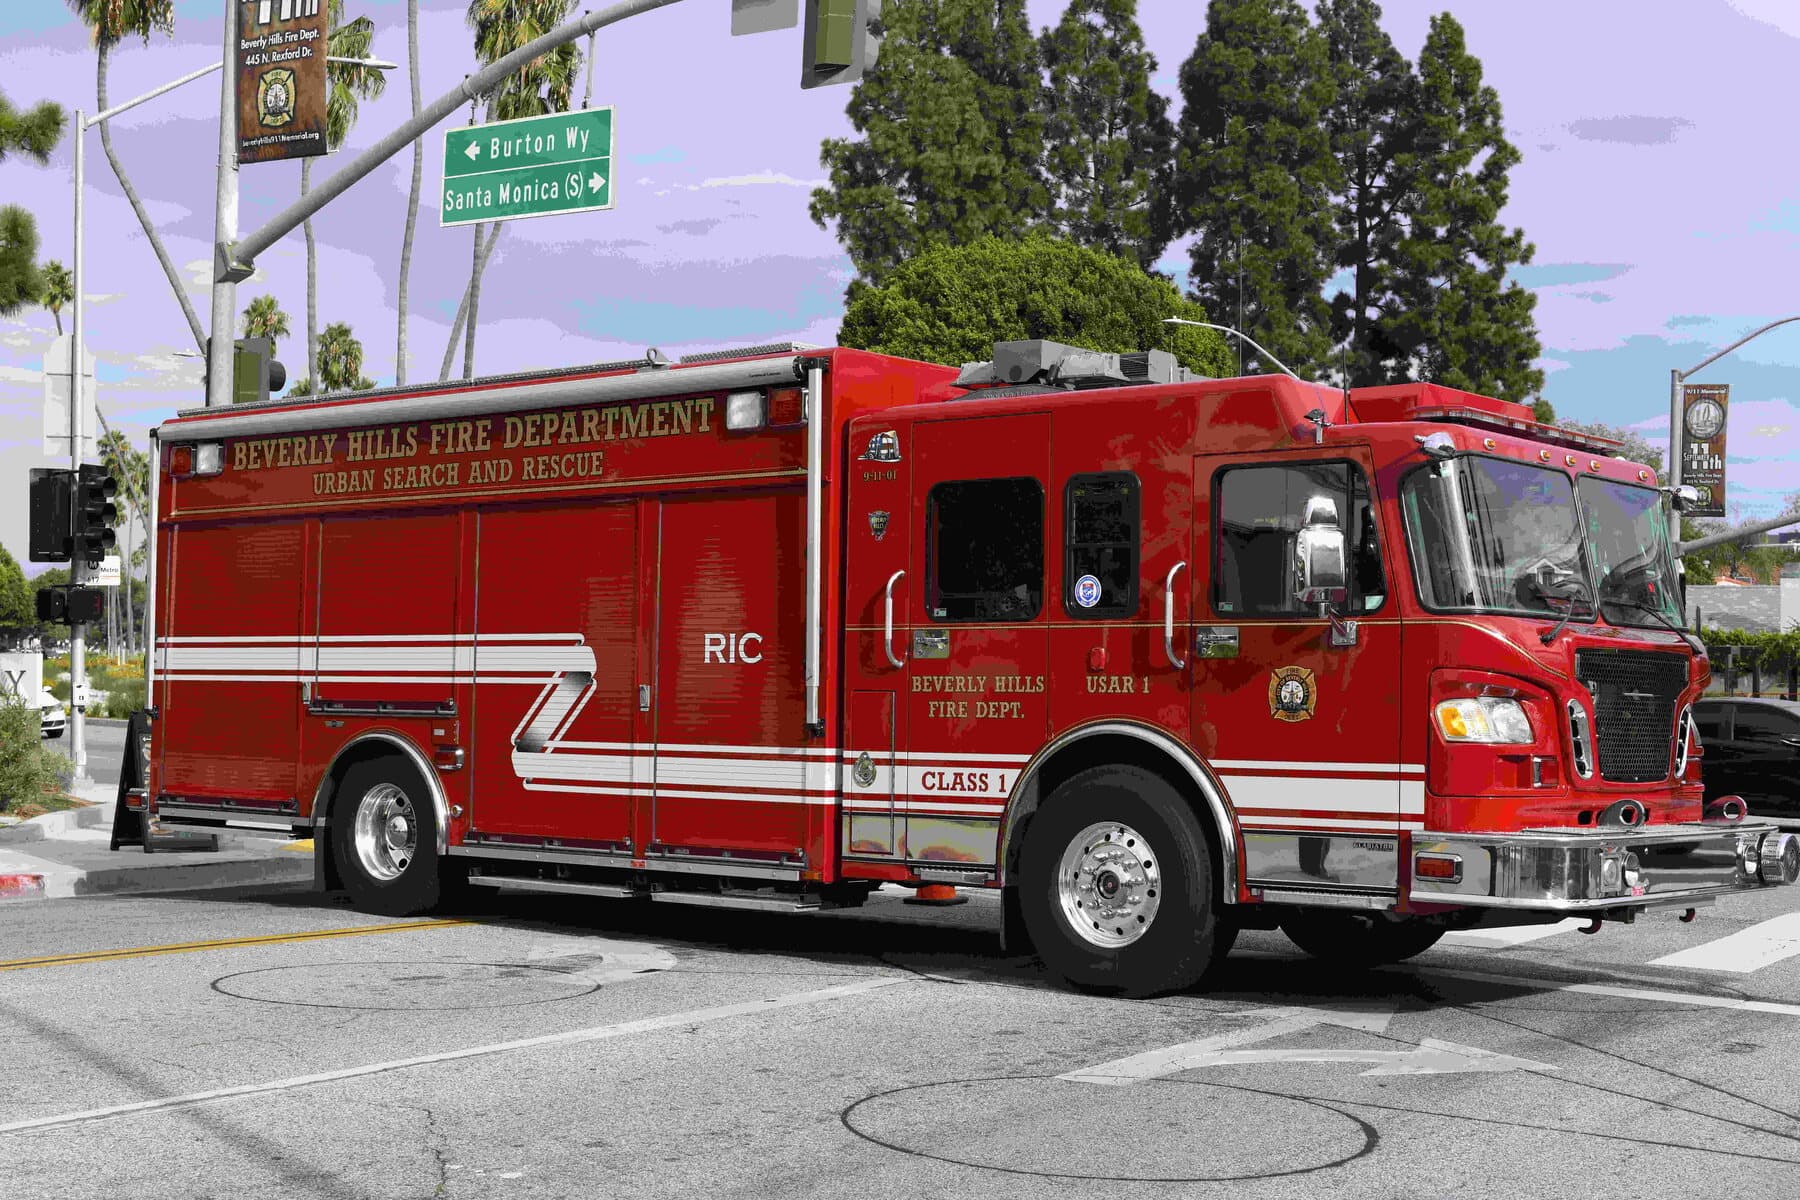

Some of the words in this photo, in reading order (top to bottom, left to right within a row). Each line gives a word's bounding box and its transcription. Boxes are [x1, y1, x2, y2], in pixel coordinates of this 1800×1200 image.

[241, 35, 267, 50] Beverly
[268, 32, 283, 46] Hills
[285, 31, 298, 42] Fire
[299, 28, 320, 42] Dept.
[245, 54, 260, 66] 445
[262, 53, 270, 64] N.
[272, 47, 300, 62] Rexford
[302, 46, 313, 57] Dr.
[490, 133, 555, 159] Burton
[566, 126, 590, 153] Wy
[445, 186, 492, 211] Santa
[499, 179, 559, 205] Monica
[565, 171, 584, 200] (S)
[232, 433, 339, 471] BEVERLY
[346, 425, 418, 462] HILLS
[429, 419, 492, 455] FIRE
[503, 398, 715, 449] DEPARTMENT
[313, 469, 376, 495] URBAN
[383, 463, 460, 490] SEARCH
[468, 458, 513, 484] AND
[522, 452, 604, 481] RESCUE
[863, 470, 897, 482] 9-11-01
[703, 632, 763, 664] RIC
[4, 670, 26, 696] Y
[911, 675, 987, 693] BEVERLY
[994, 675, 1045, 694] HILLS
[1085, 675, 1135, 694] USAR
[1142, 675, 1150, 694] 1
[928, 701, 969, 719] FIRE
[975, 701, 1025, 720] DEPT.
[921, 770, 989, 792] CLASS
[998, 773, 1007, 793] 1
